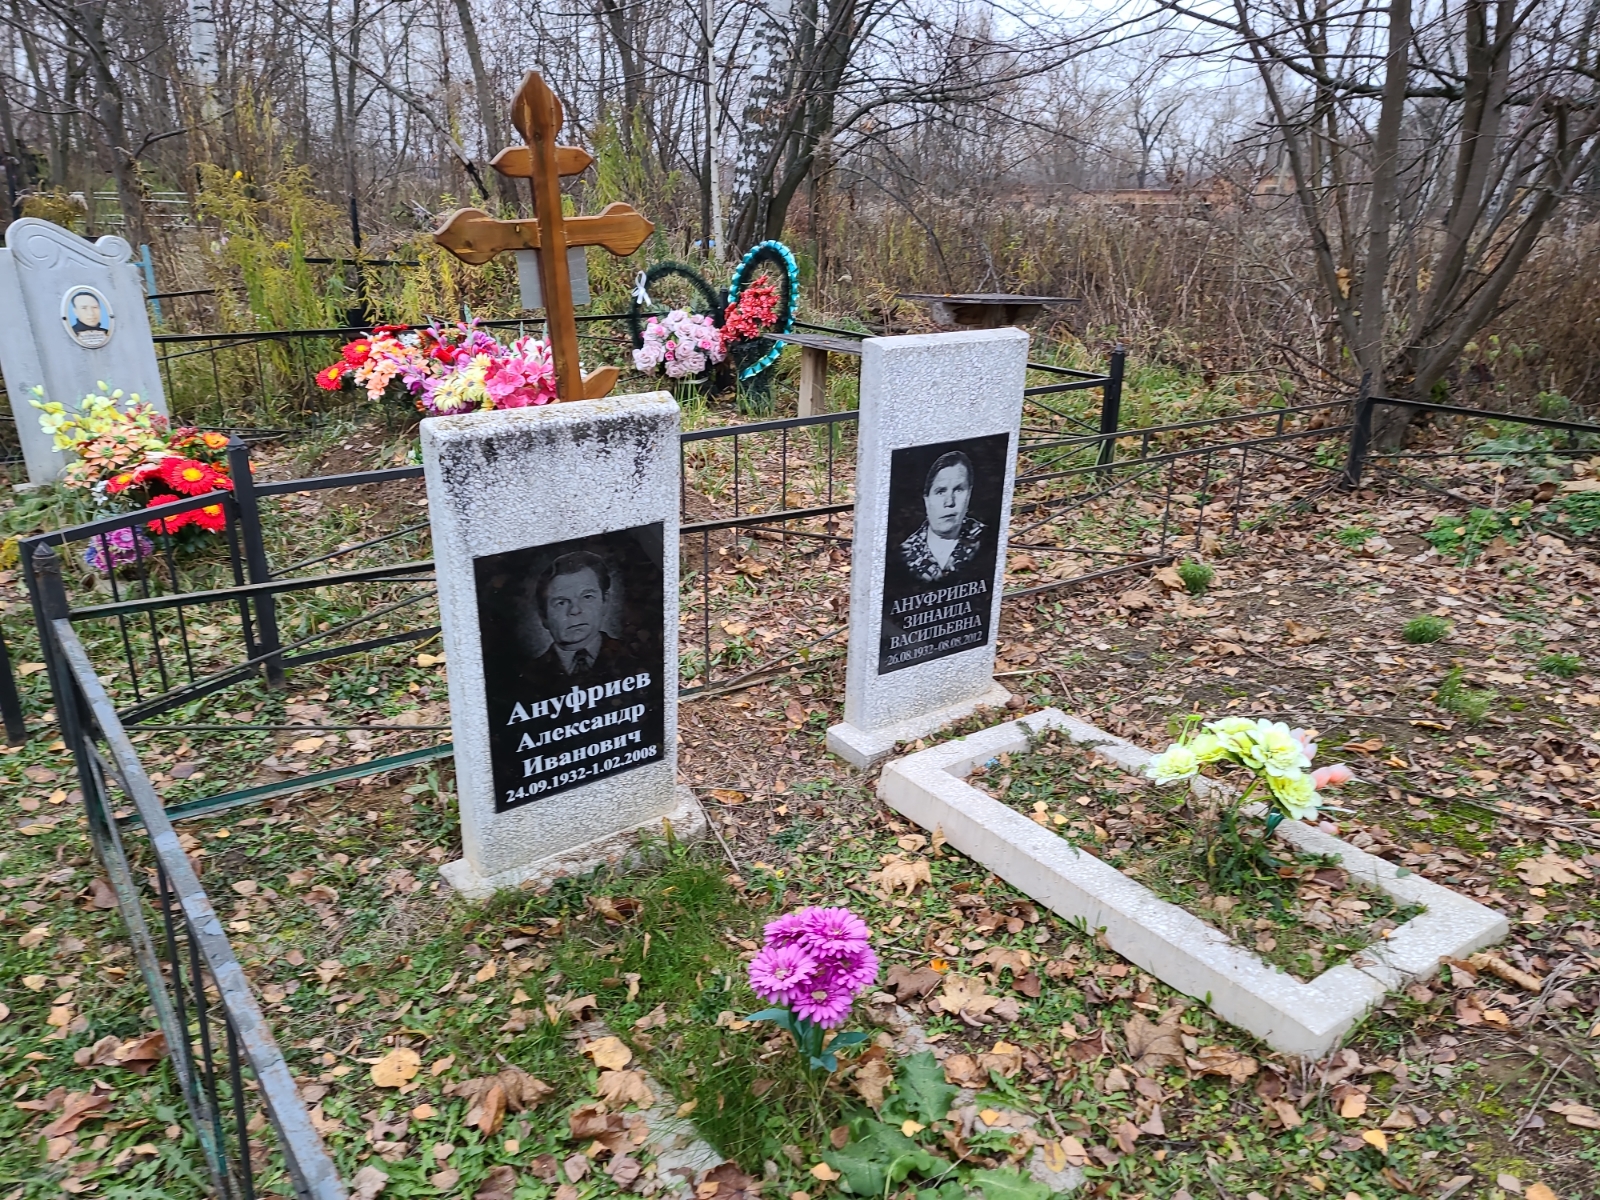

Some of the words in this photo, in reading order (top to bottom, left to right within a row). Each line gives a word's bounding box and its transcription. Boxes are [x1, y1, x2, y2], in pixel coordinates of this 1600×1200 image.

[890, 579, 988, 615] АНУФРИЕВА
[902, 601, 972, 629] ЗИНАИДА
[889, 615, 982, 649] ВАСИЛЬЕВНА
[506, 672, 652, 726] Ануфриев
[515, 703, 646, 752] Александр
[505, 744, 657, 803] 24.09.1932-1.02.2008
[521, 729, 642, 778] Иванович
